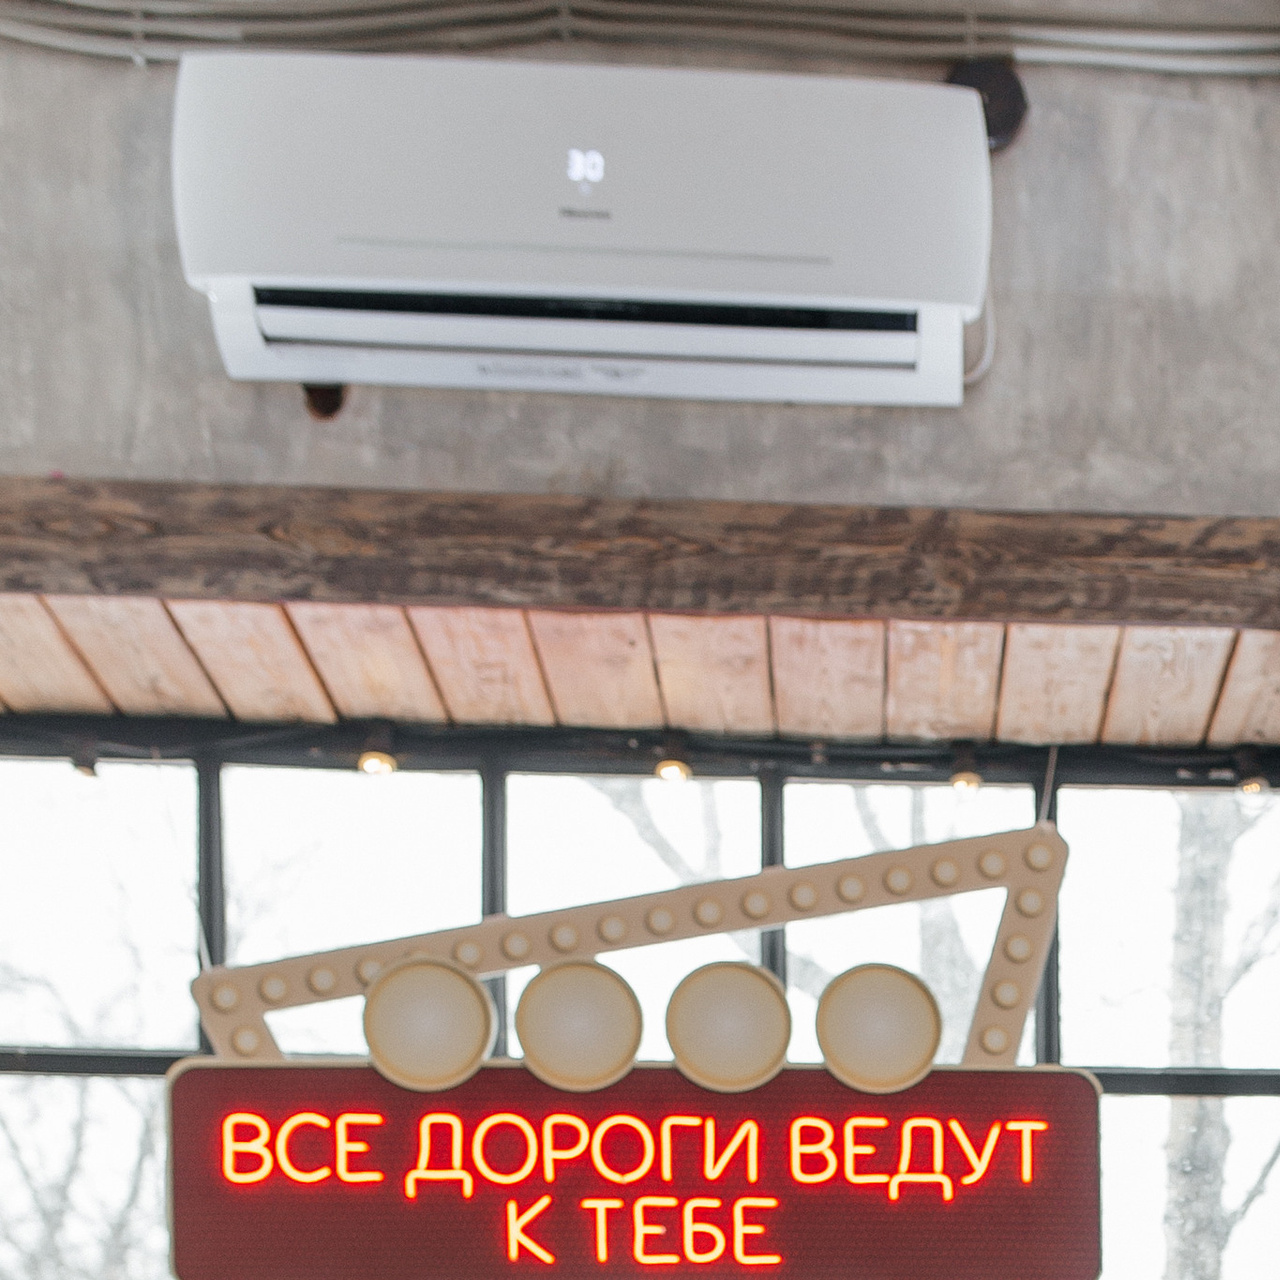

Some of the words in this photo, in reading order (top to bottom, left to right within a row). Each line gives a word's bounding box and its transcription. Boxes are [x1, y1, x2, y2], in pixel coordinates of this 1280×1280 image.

[220, 1111, 385, 1185] ВСЕ
[404, 1112, 760, 1199] ДОРОГИ
[788, 1116, 1049, 1202] ВЕДУТ
[504, 1195, 557, 1266] К
[581, 1197, 782, 1267] ТЕБЕ
